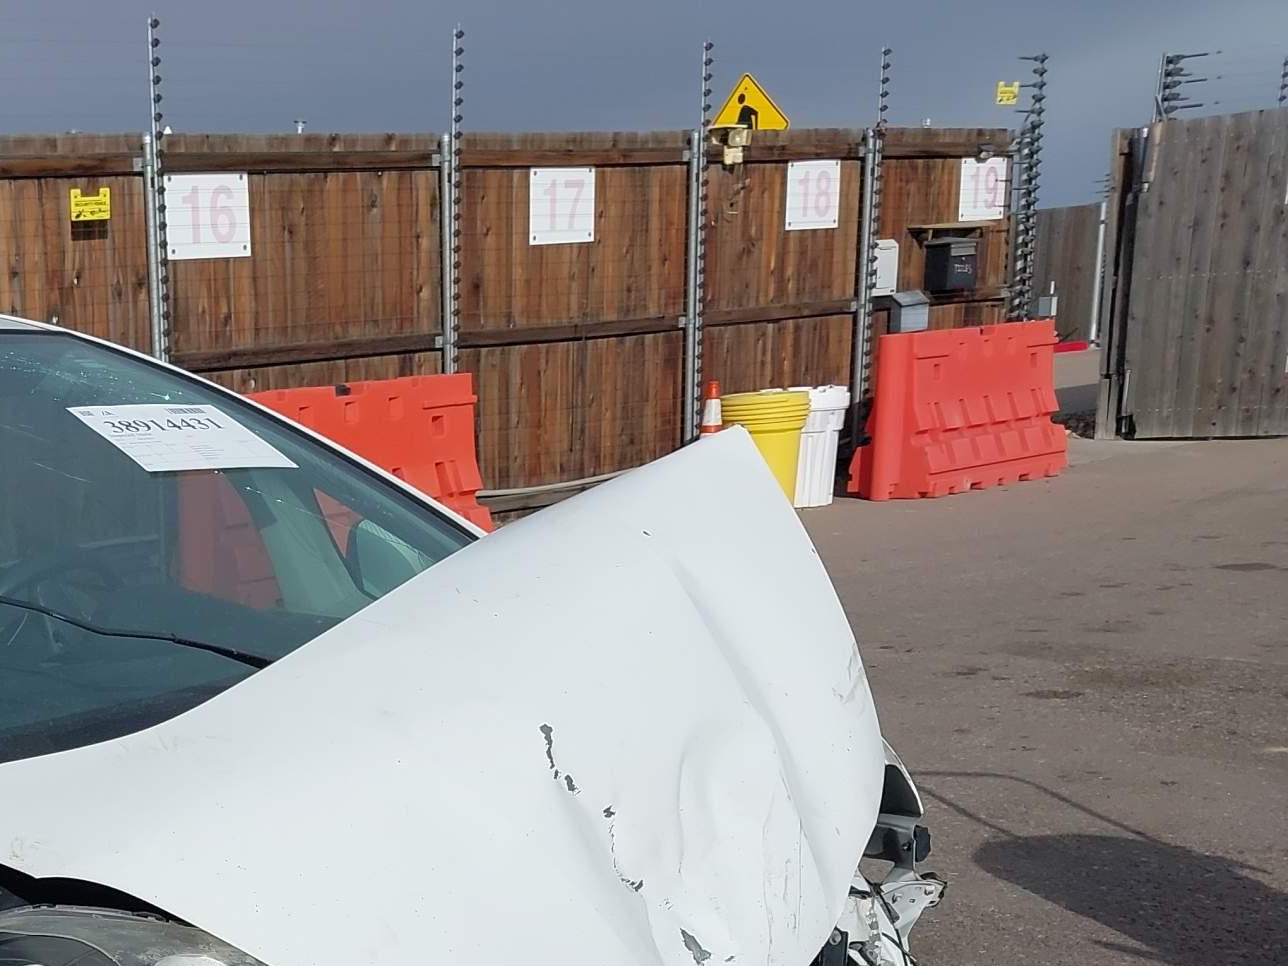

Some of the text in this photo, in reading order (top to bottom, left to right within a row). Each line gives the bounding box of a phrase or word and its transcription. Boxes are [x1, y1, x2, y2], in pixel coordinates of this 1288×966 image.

[543, 178, 585, 231] 17
[798, 169, 832, 218] 18
[970, 166, 999, 210] 19
[181, 184, 236, 244] 16
[103, 417, 225, 434] 38914431
